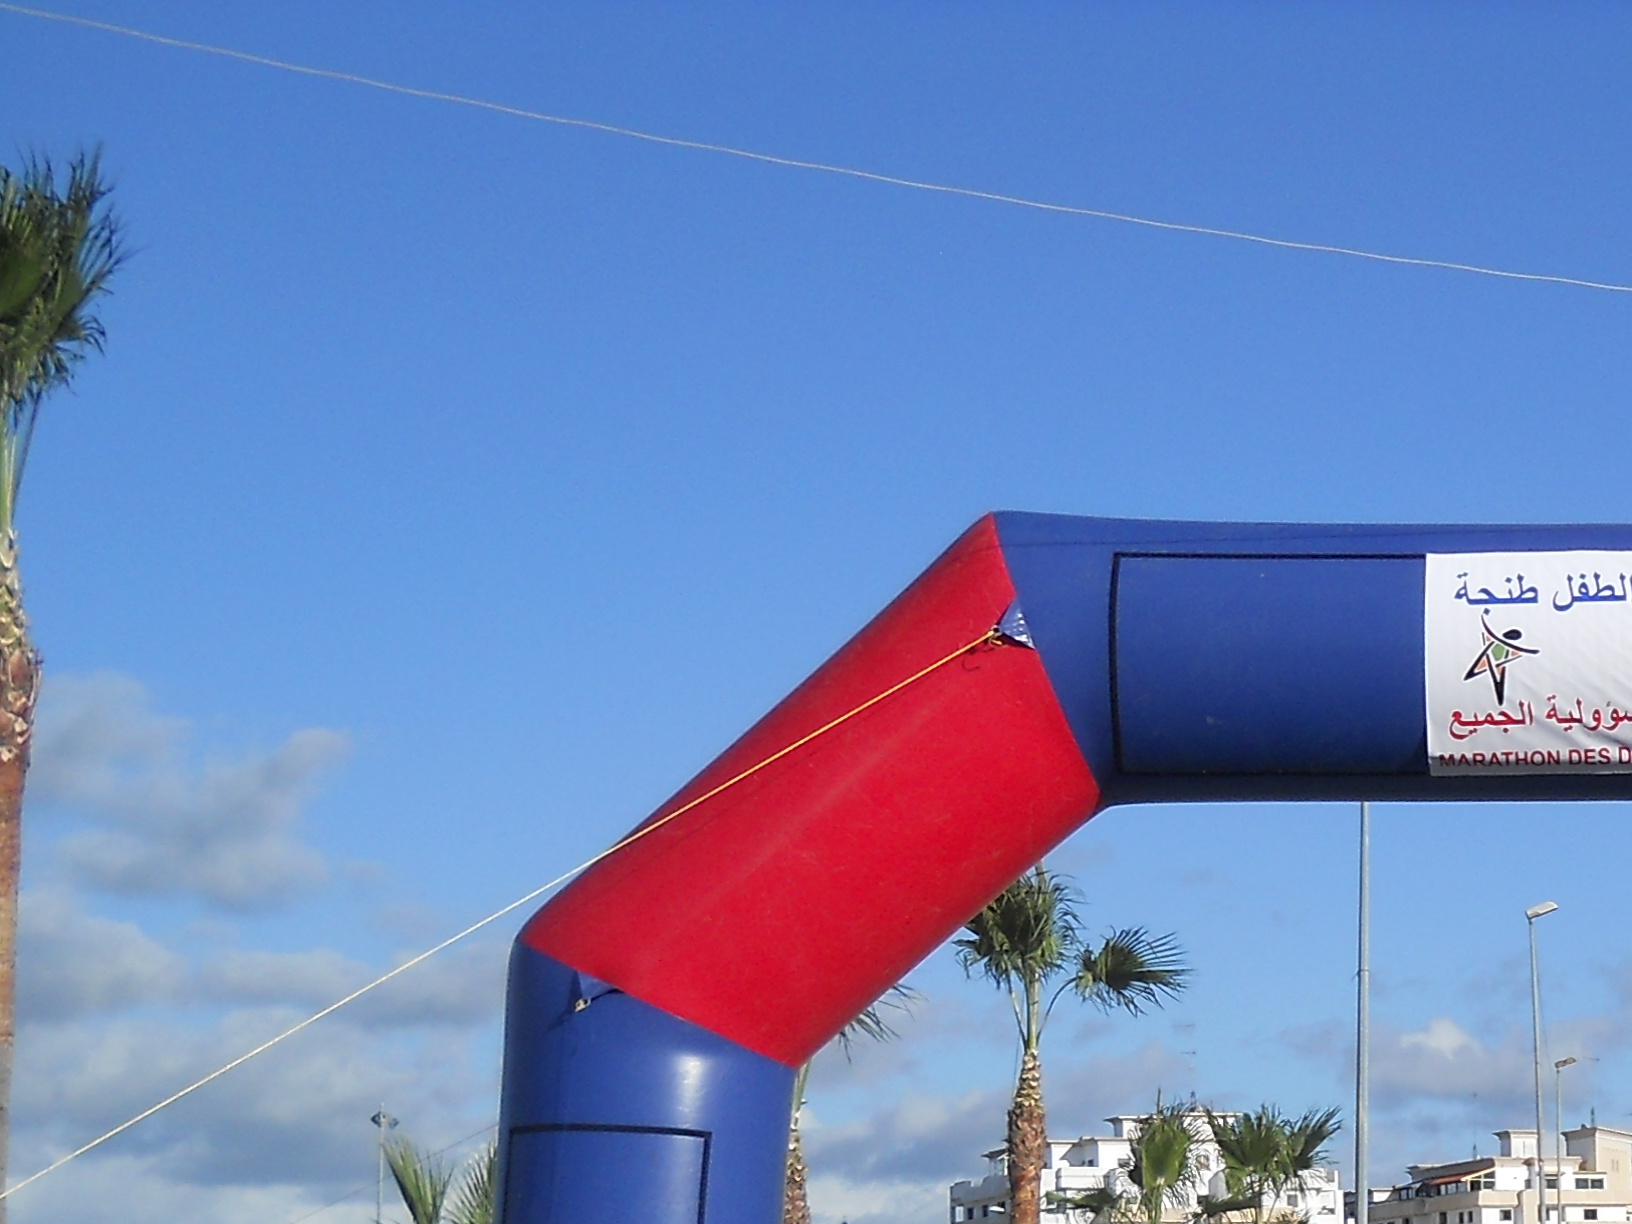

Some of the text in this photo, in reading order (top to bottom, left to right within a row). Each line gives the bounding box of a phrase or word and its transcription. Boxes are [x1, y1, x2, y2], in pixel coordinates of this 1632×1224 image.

[1454, 572, 1539, 616] طنجة
[1449, 700, 1534, 740] الجميع
[1439, 751, 1559, 768] MARATHON
[1568, 749, 1611, 765] DES
